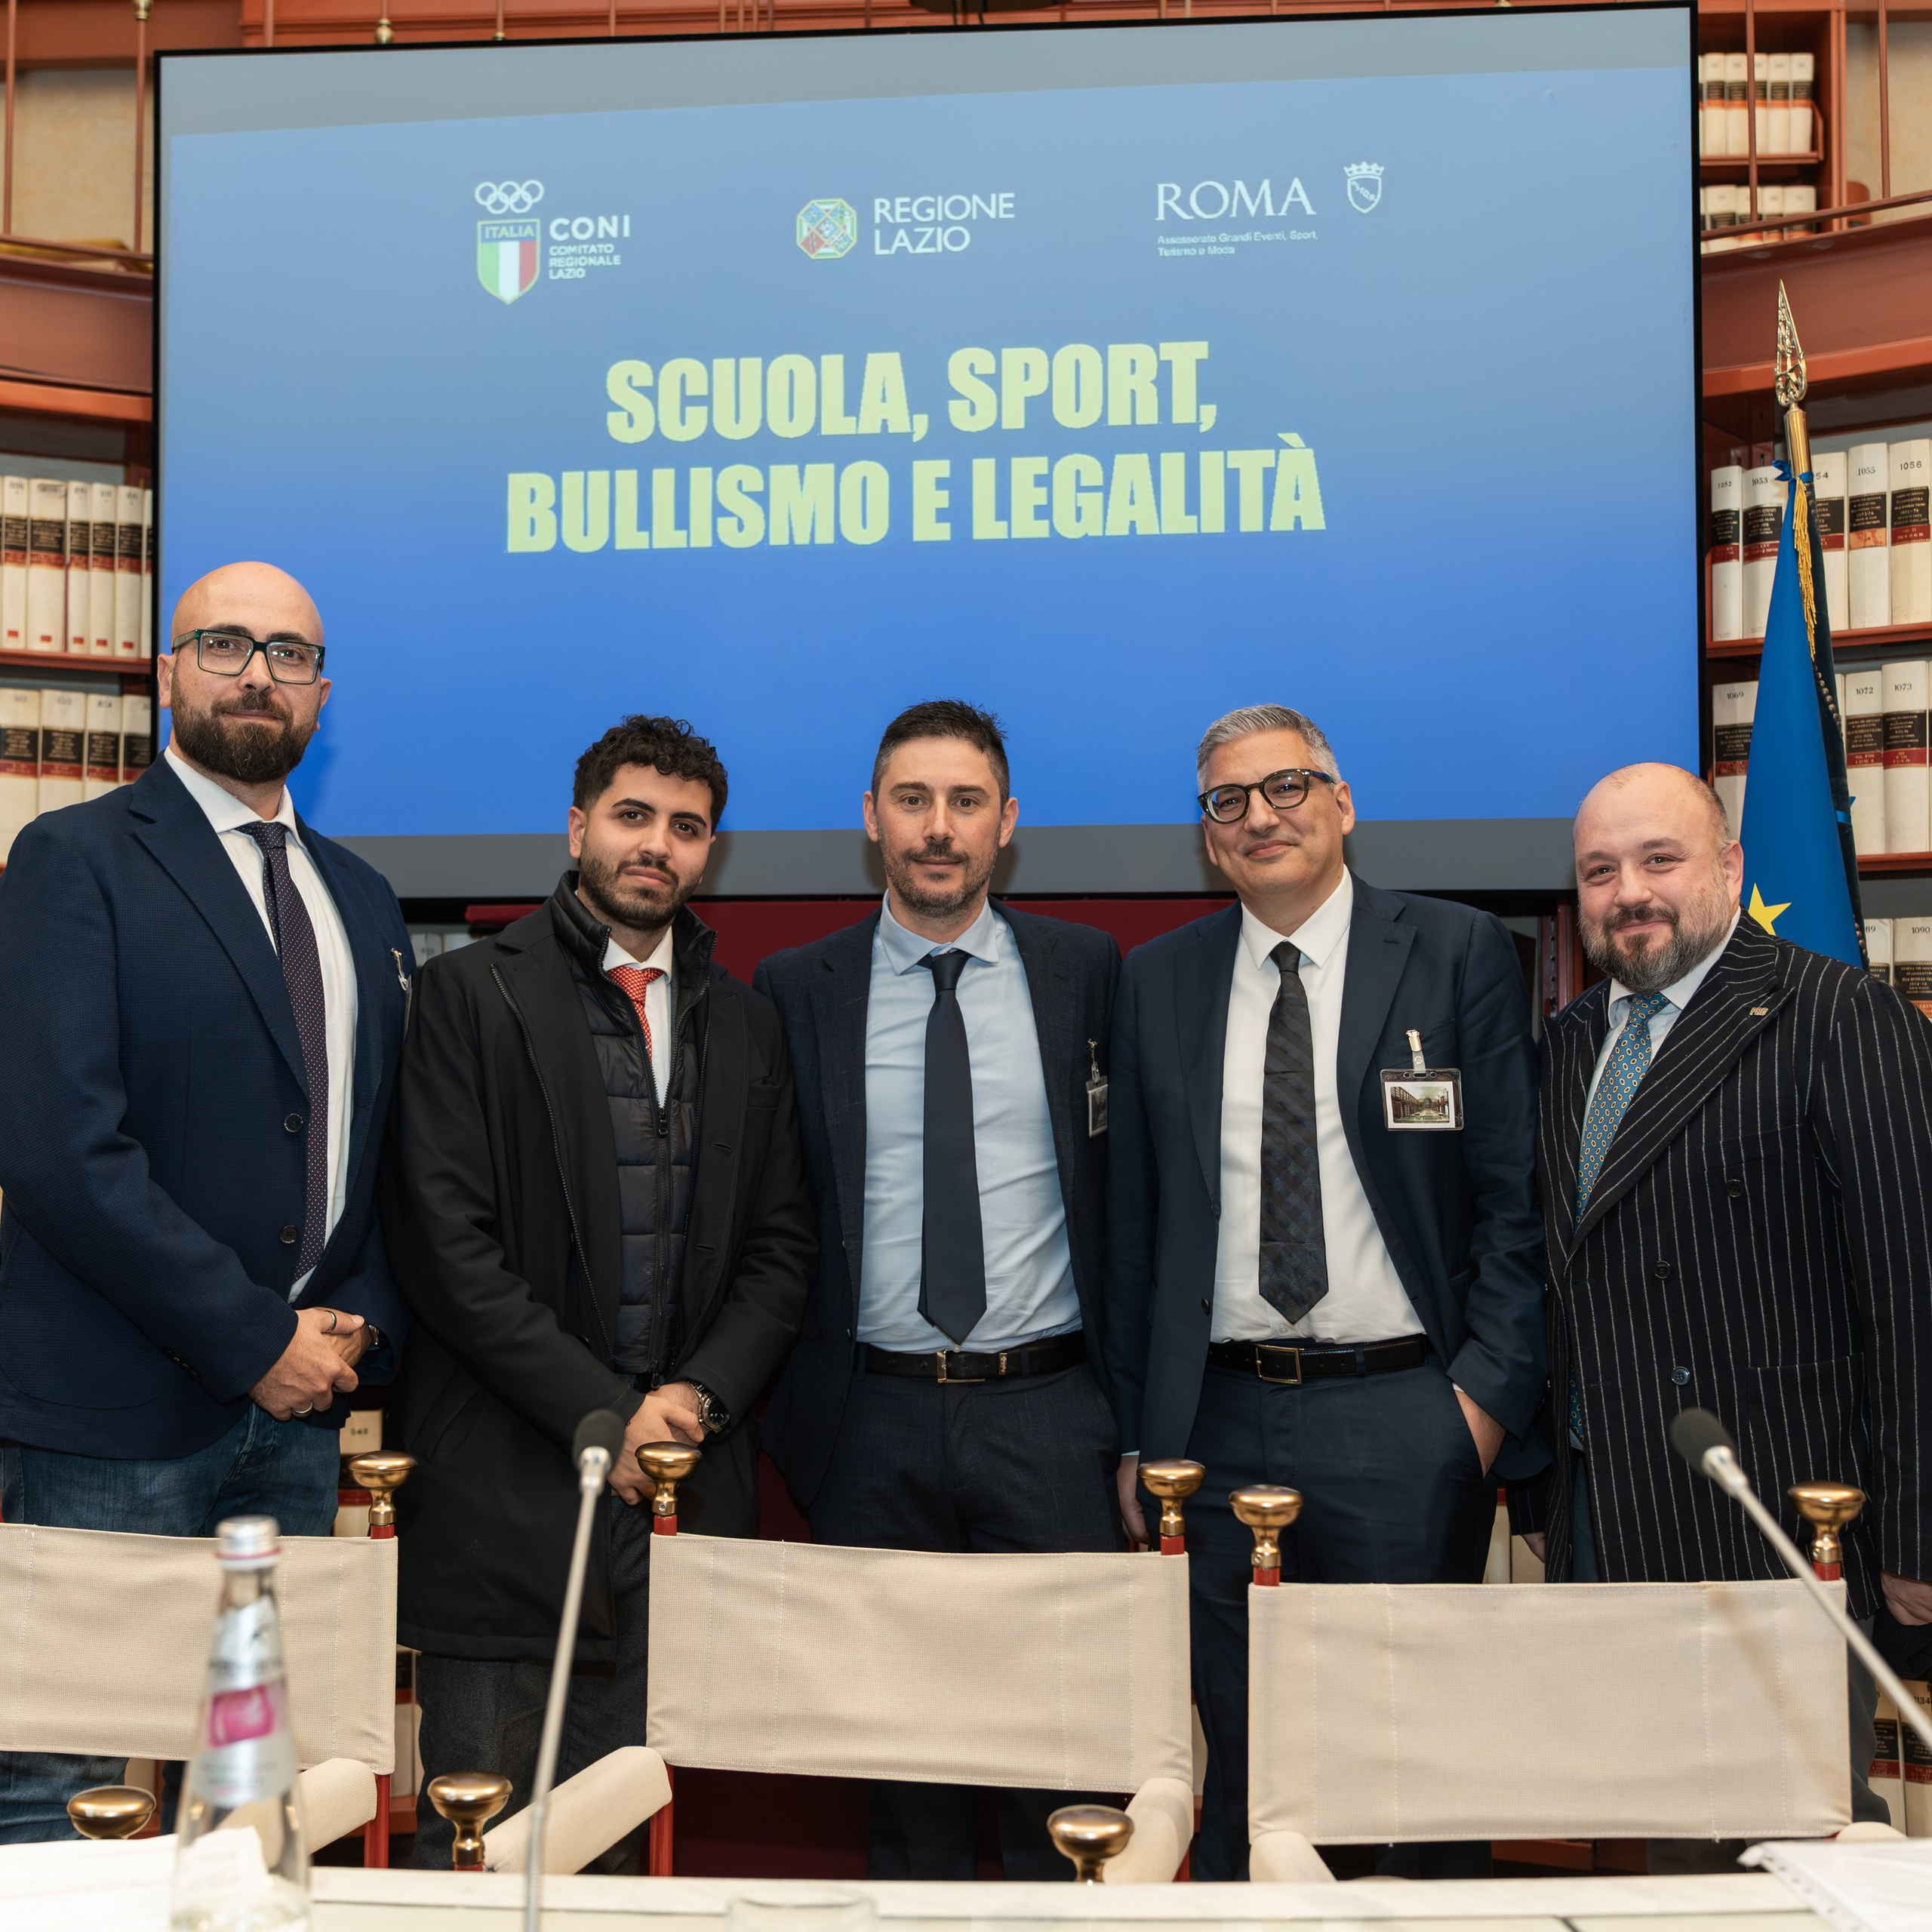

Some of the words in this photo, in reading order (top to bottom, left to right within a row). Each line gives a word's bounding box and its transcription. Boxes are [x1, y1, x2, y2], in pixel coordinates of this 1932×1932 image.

[1155, 177, 1317, 221] ROMA
[874, 192, 1015, 224] REGIONE
[485, 225, 535, 238] ITALIA
[549, 214, 630, 242] CONI
[874, 226, 971, 255] LAZIO
[1157, 235, 1217, 245] Assessorato
[1218, 232, 1252, 242] Grandi
[549, 244, 614, 256] COMITATO
[1158, 247, 1197, 257] Turismo
[1207, 246, 1235, 255] Moda
[549, 255, 621, 268] REGIONALE
[549, 267, 586, 280] LAZIO
[606, 352, 929, 444] SCUOLA,
[948, 341, 1217, 432] SPORT,
[1857, 467, 1876, 476] 1055
[1900, 460, 1922, 471] 1056
[1752, 477, 1768, 487] 1053
[1816, 472, 1829, 480] 54
[507, 460, 890, 553] BULLISMO
[912, 460, 951, 542] E
[972, 432, 1326, 540] LEGALITÀ
[1856, 687, 1874, 695] 1072
[1894, 683, 1912, 691] 1073
[1727, 691, 1744, 700] 1069
